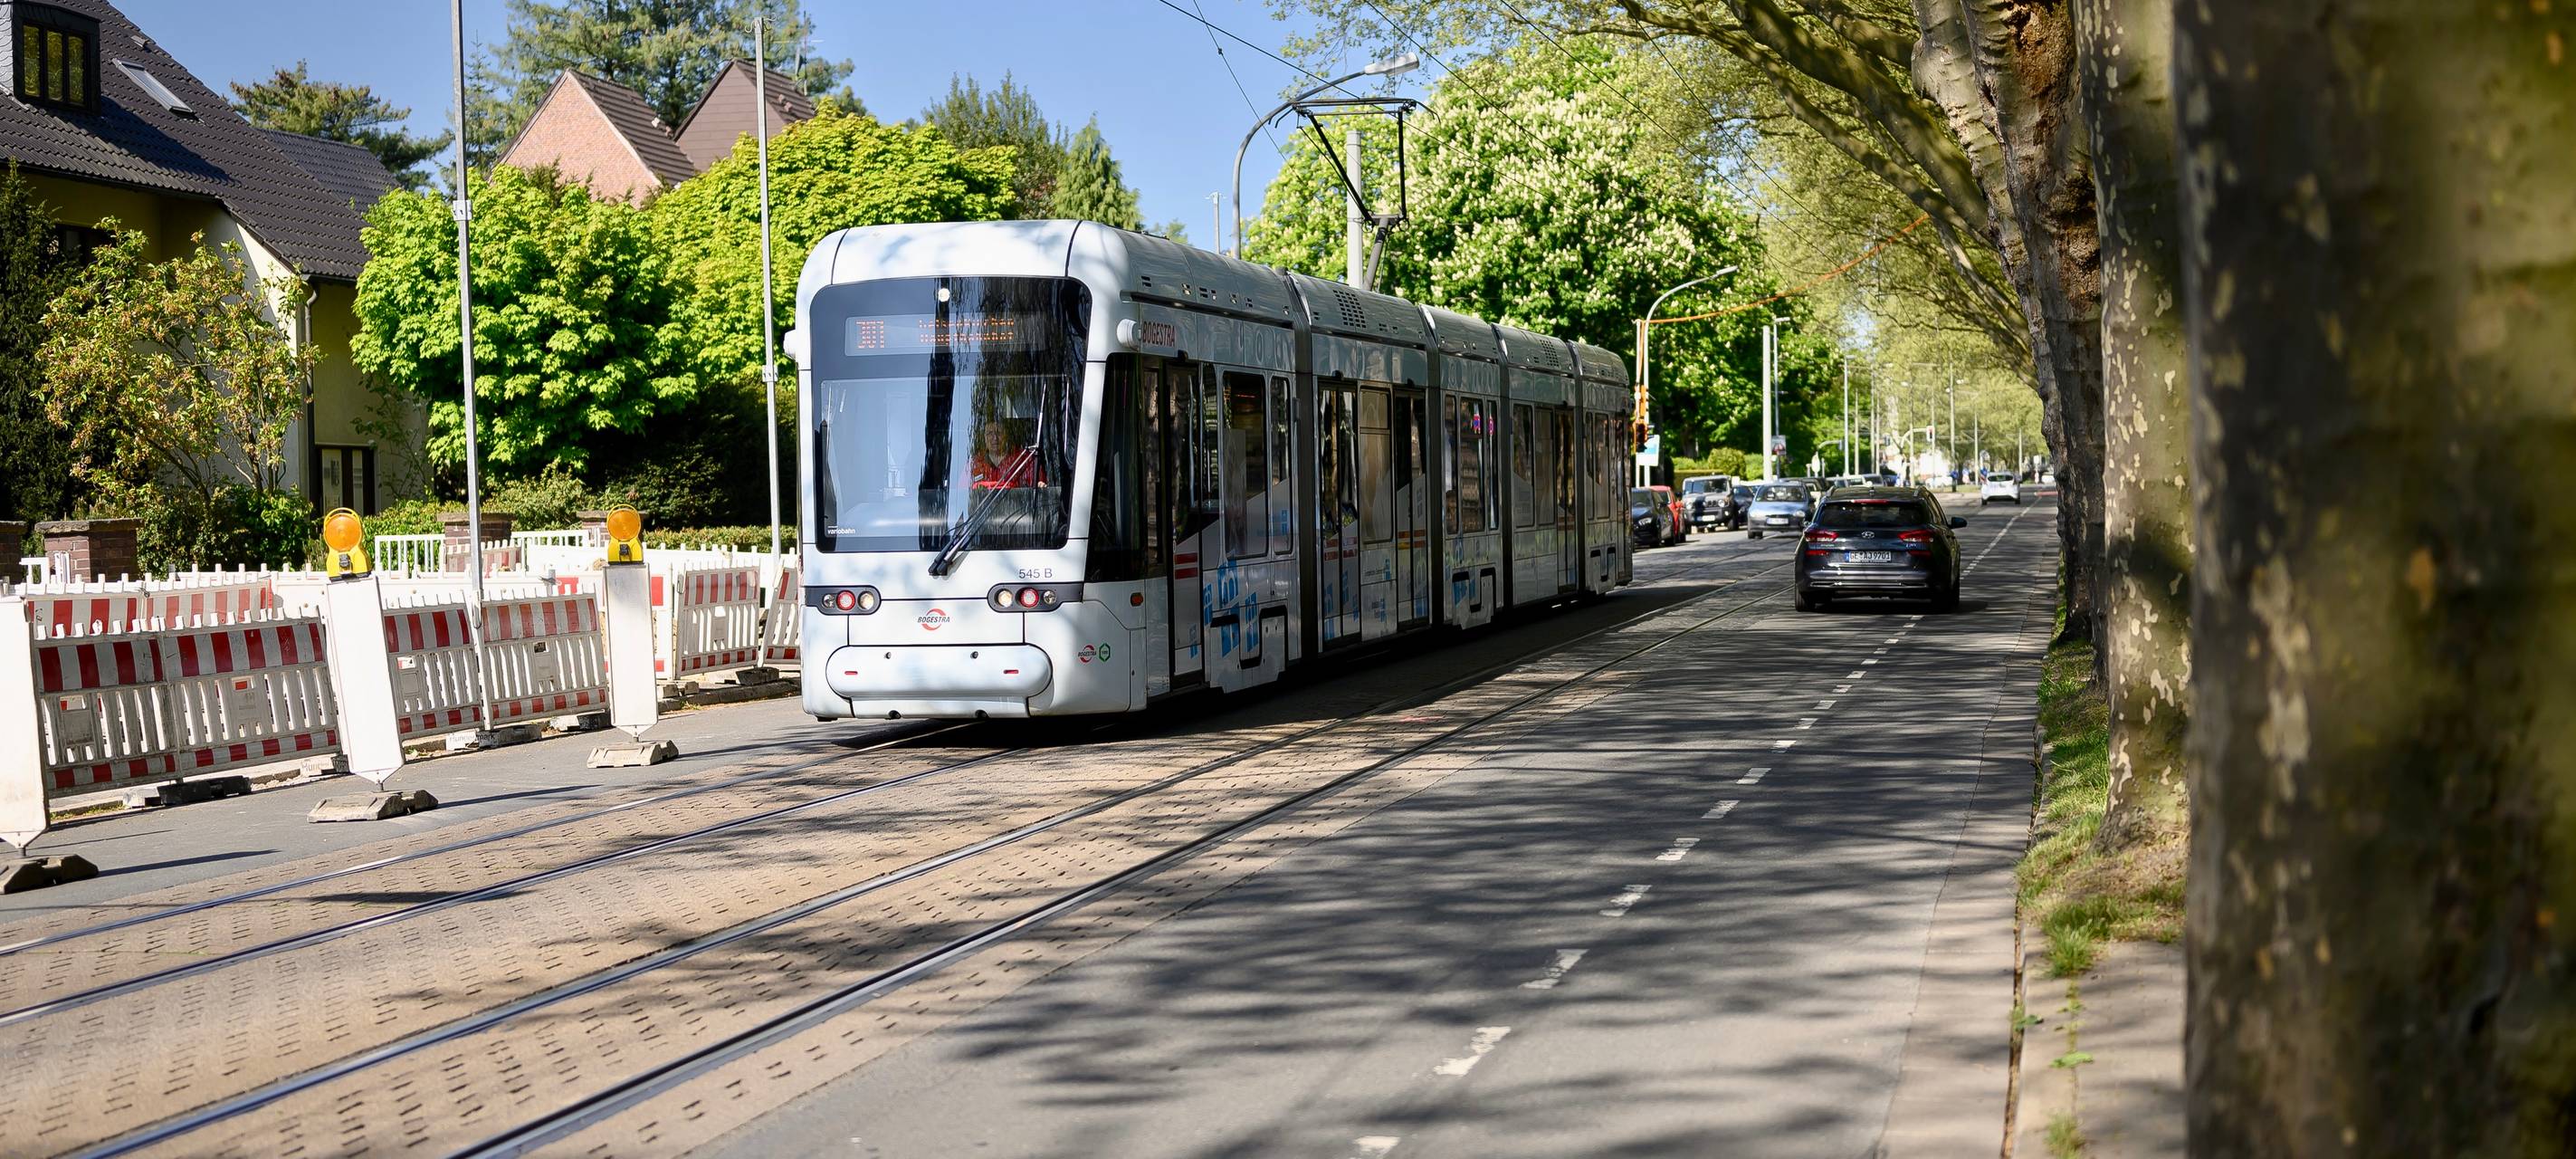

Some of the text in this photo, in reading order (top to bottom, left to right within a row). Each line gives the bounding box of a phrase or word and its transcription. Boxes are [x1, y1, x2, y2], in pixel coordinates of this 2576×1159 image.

[1142, 321, 1175, 348] BOGESTRA
[1018, 568, 1053, 580] 545 B
